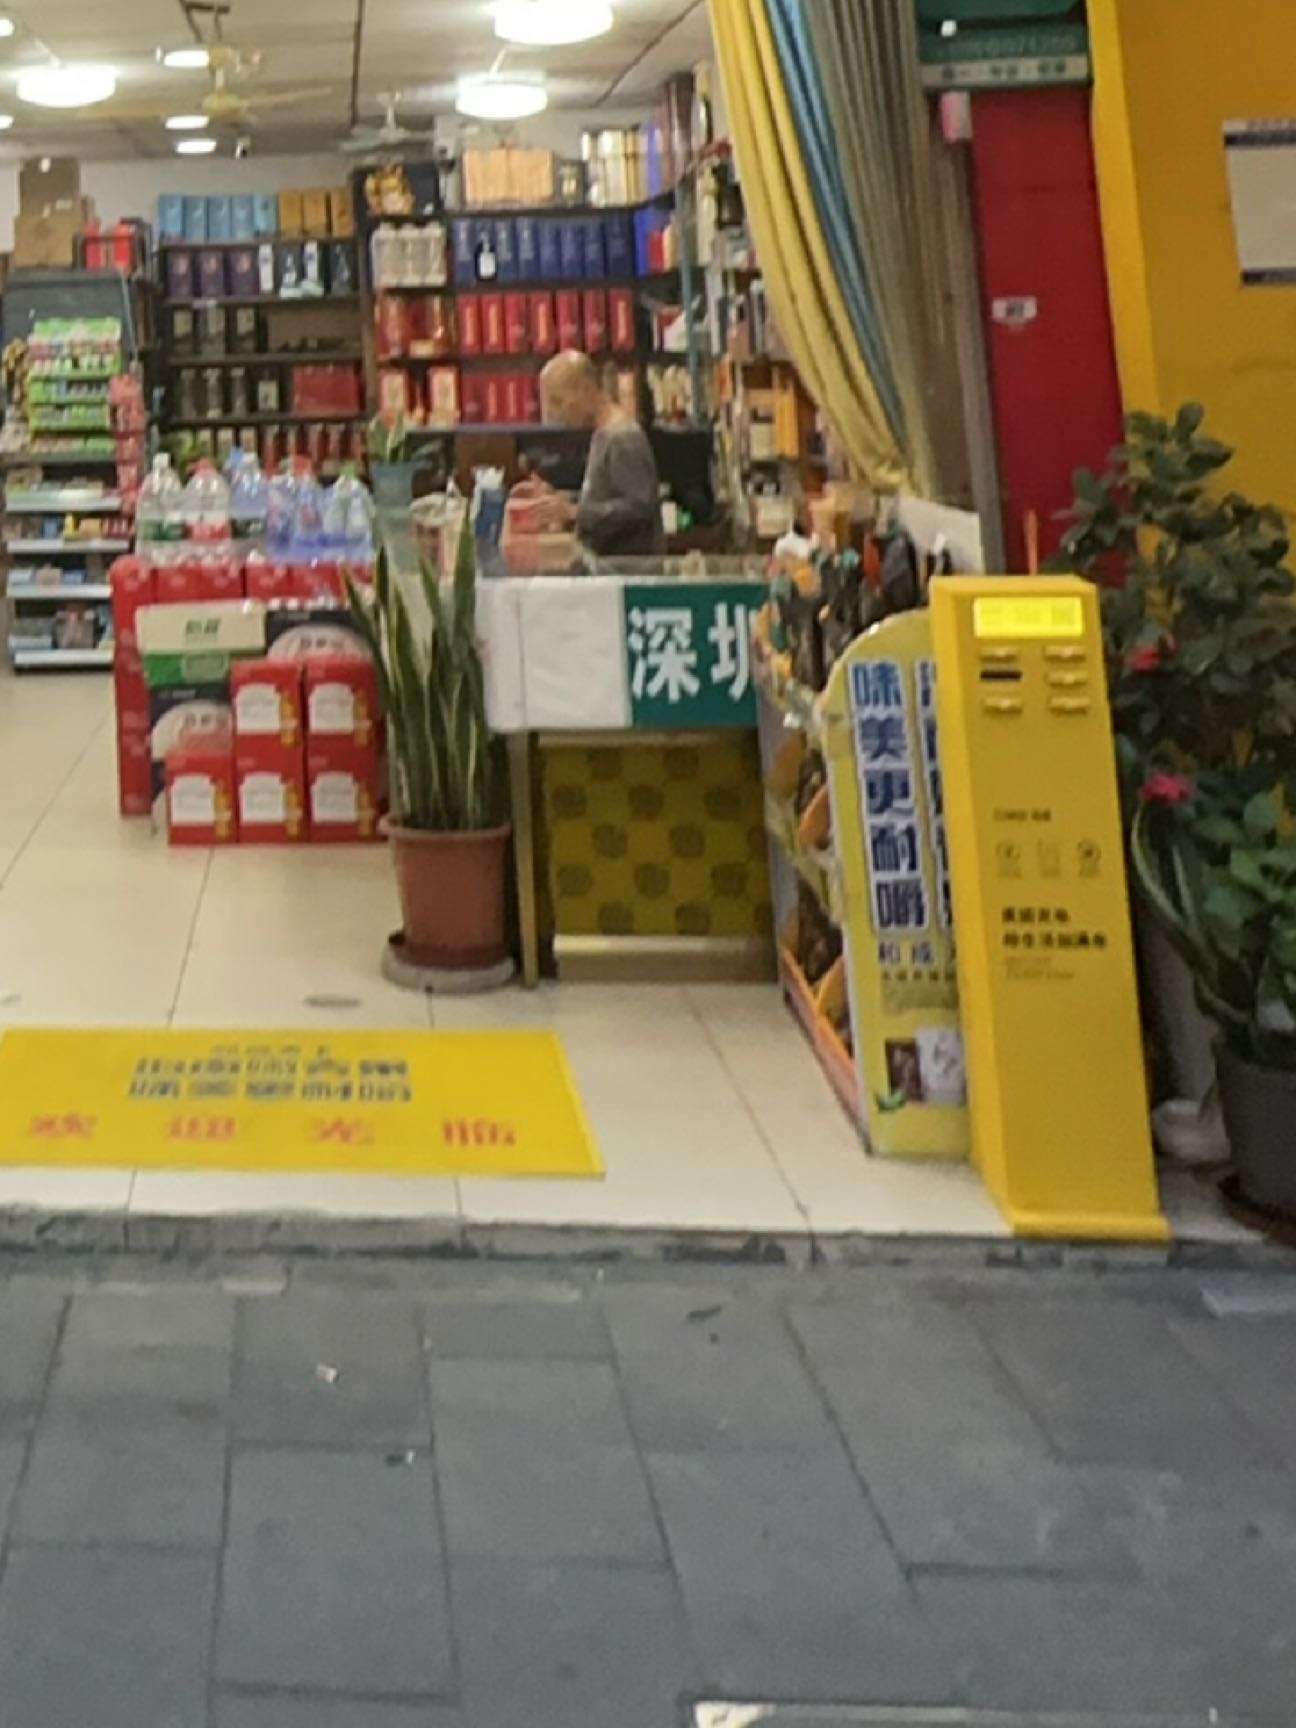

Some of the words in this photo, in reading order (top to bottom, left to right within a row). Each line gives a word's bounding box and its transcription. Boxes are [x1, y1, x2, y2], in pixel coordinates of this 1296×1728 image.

[852, 659, 928, 929] 味美更耐嚼
